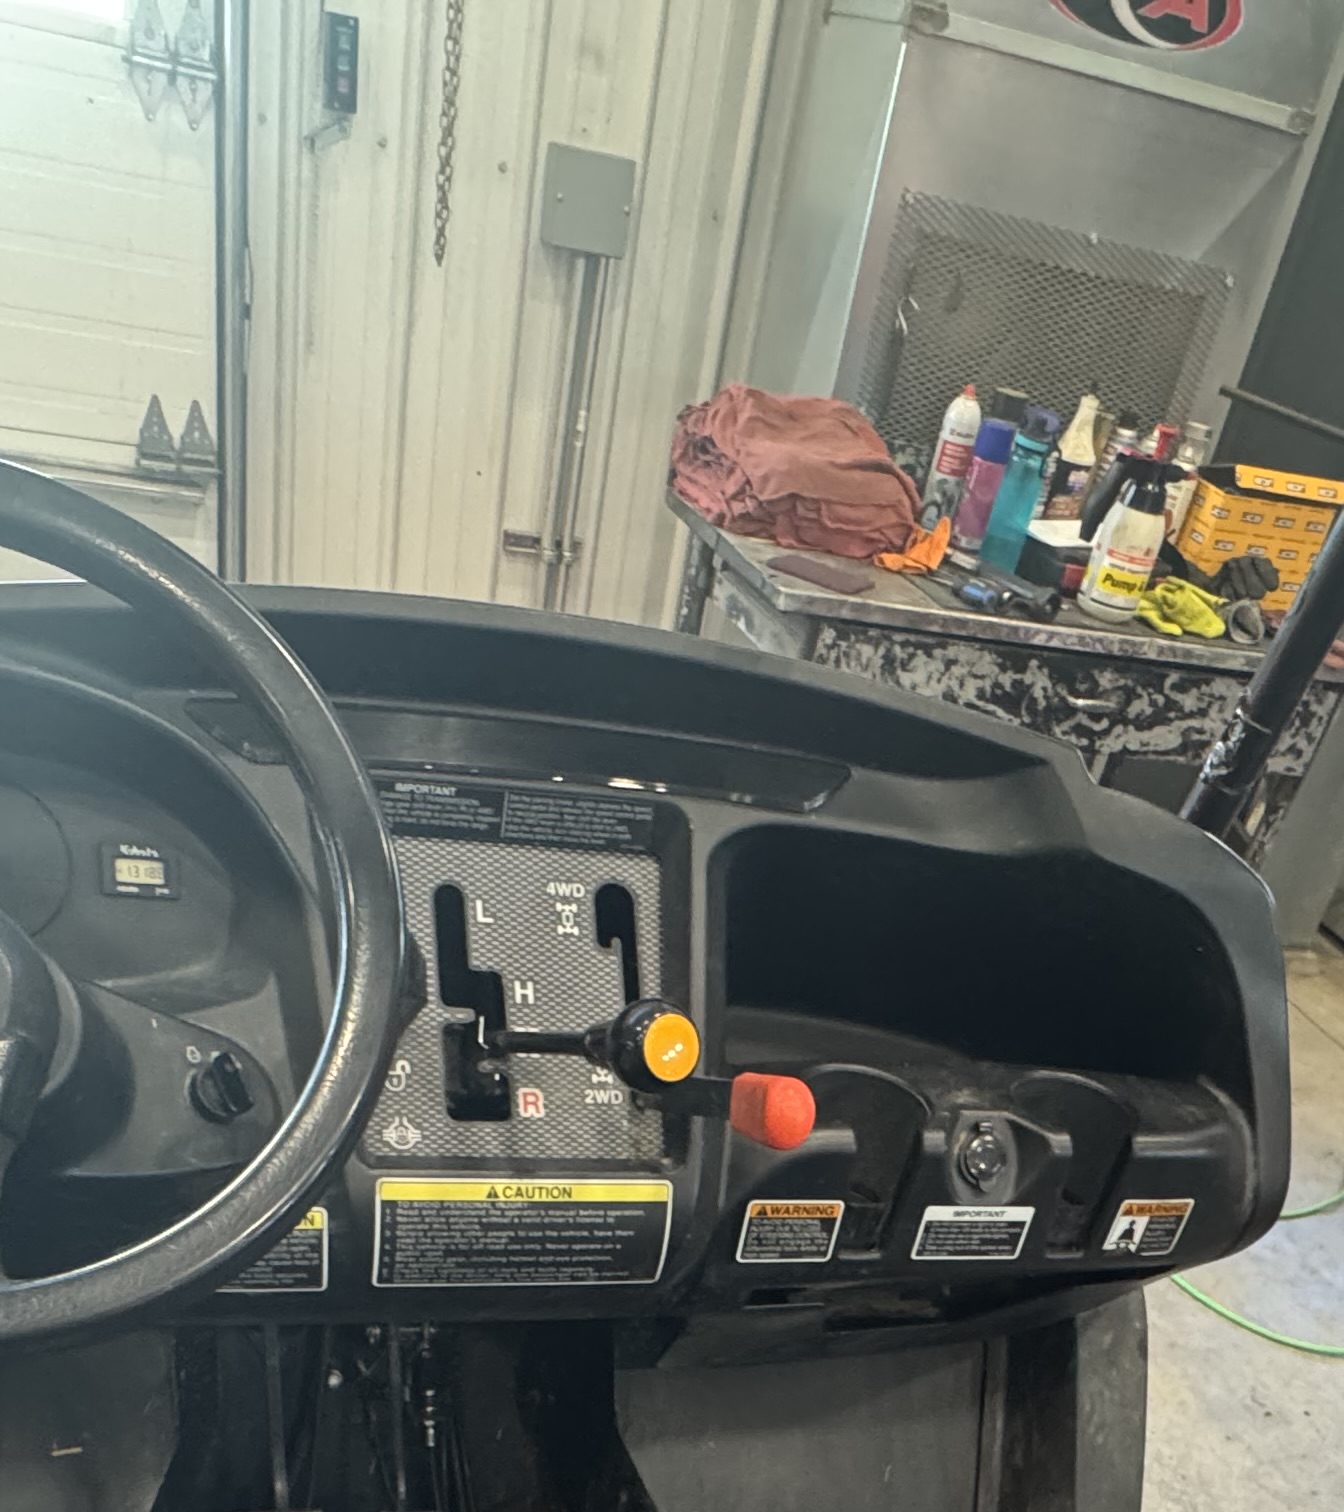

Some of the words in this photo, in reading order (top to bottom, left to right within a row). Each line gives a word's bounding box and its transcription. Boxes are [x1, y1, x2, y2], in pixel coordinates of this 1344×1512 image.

[395, 783, 458, 796] IMPORTANT
[546, 881, 585, 898] 4WD
[475, 899, 494, 923] L
[514, 980, 535, 1004] H
[520, 1090, 543, 1116] R
[584, 1089, 623, 1105] 2WD
[502, 1186, 572, 1199] CAUTION
[769, 1205, 835, 1216] WARNING
[952, 1210, 1008, 1218] IMPORTANT
